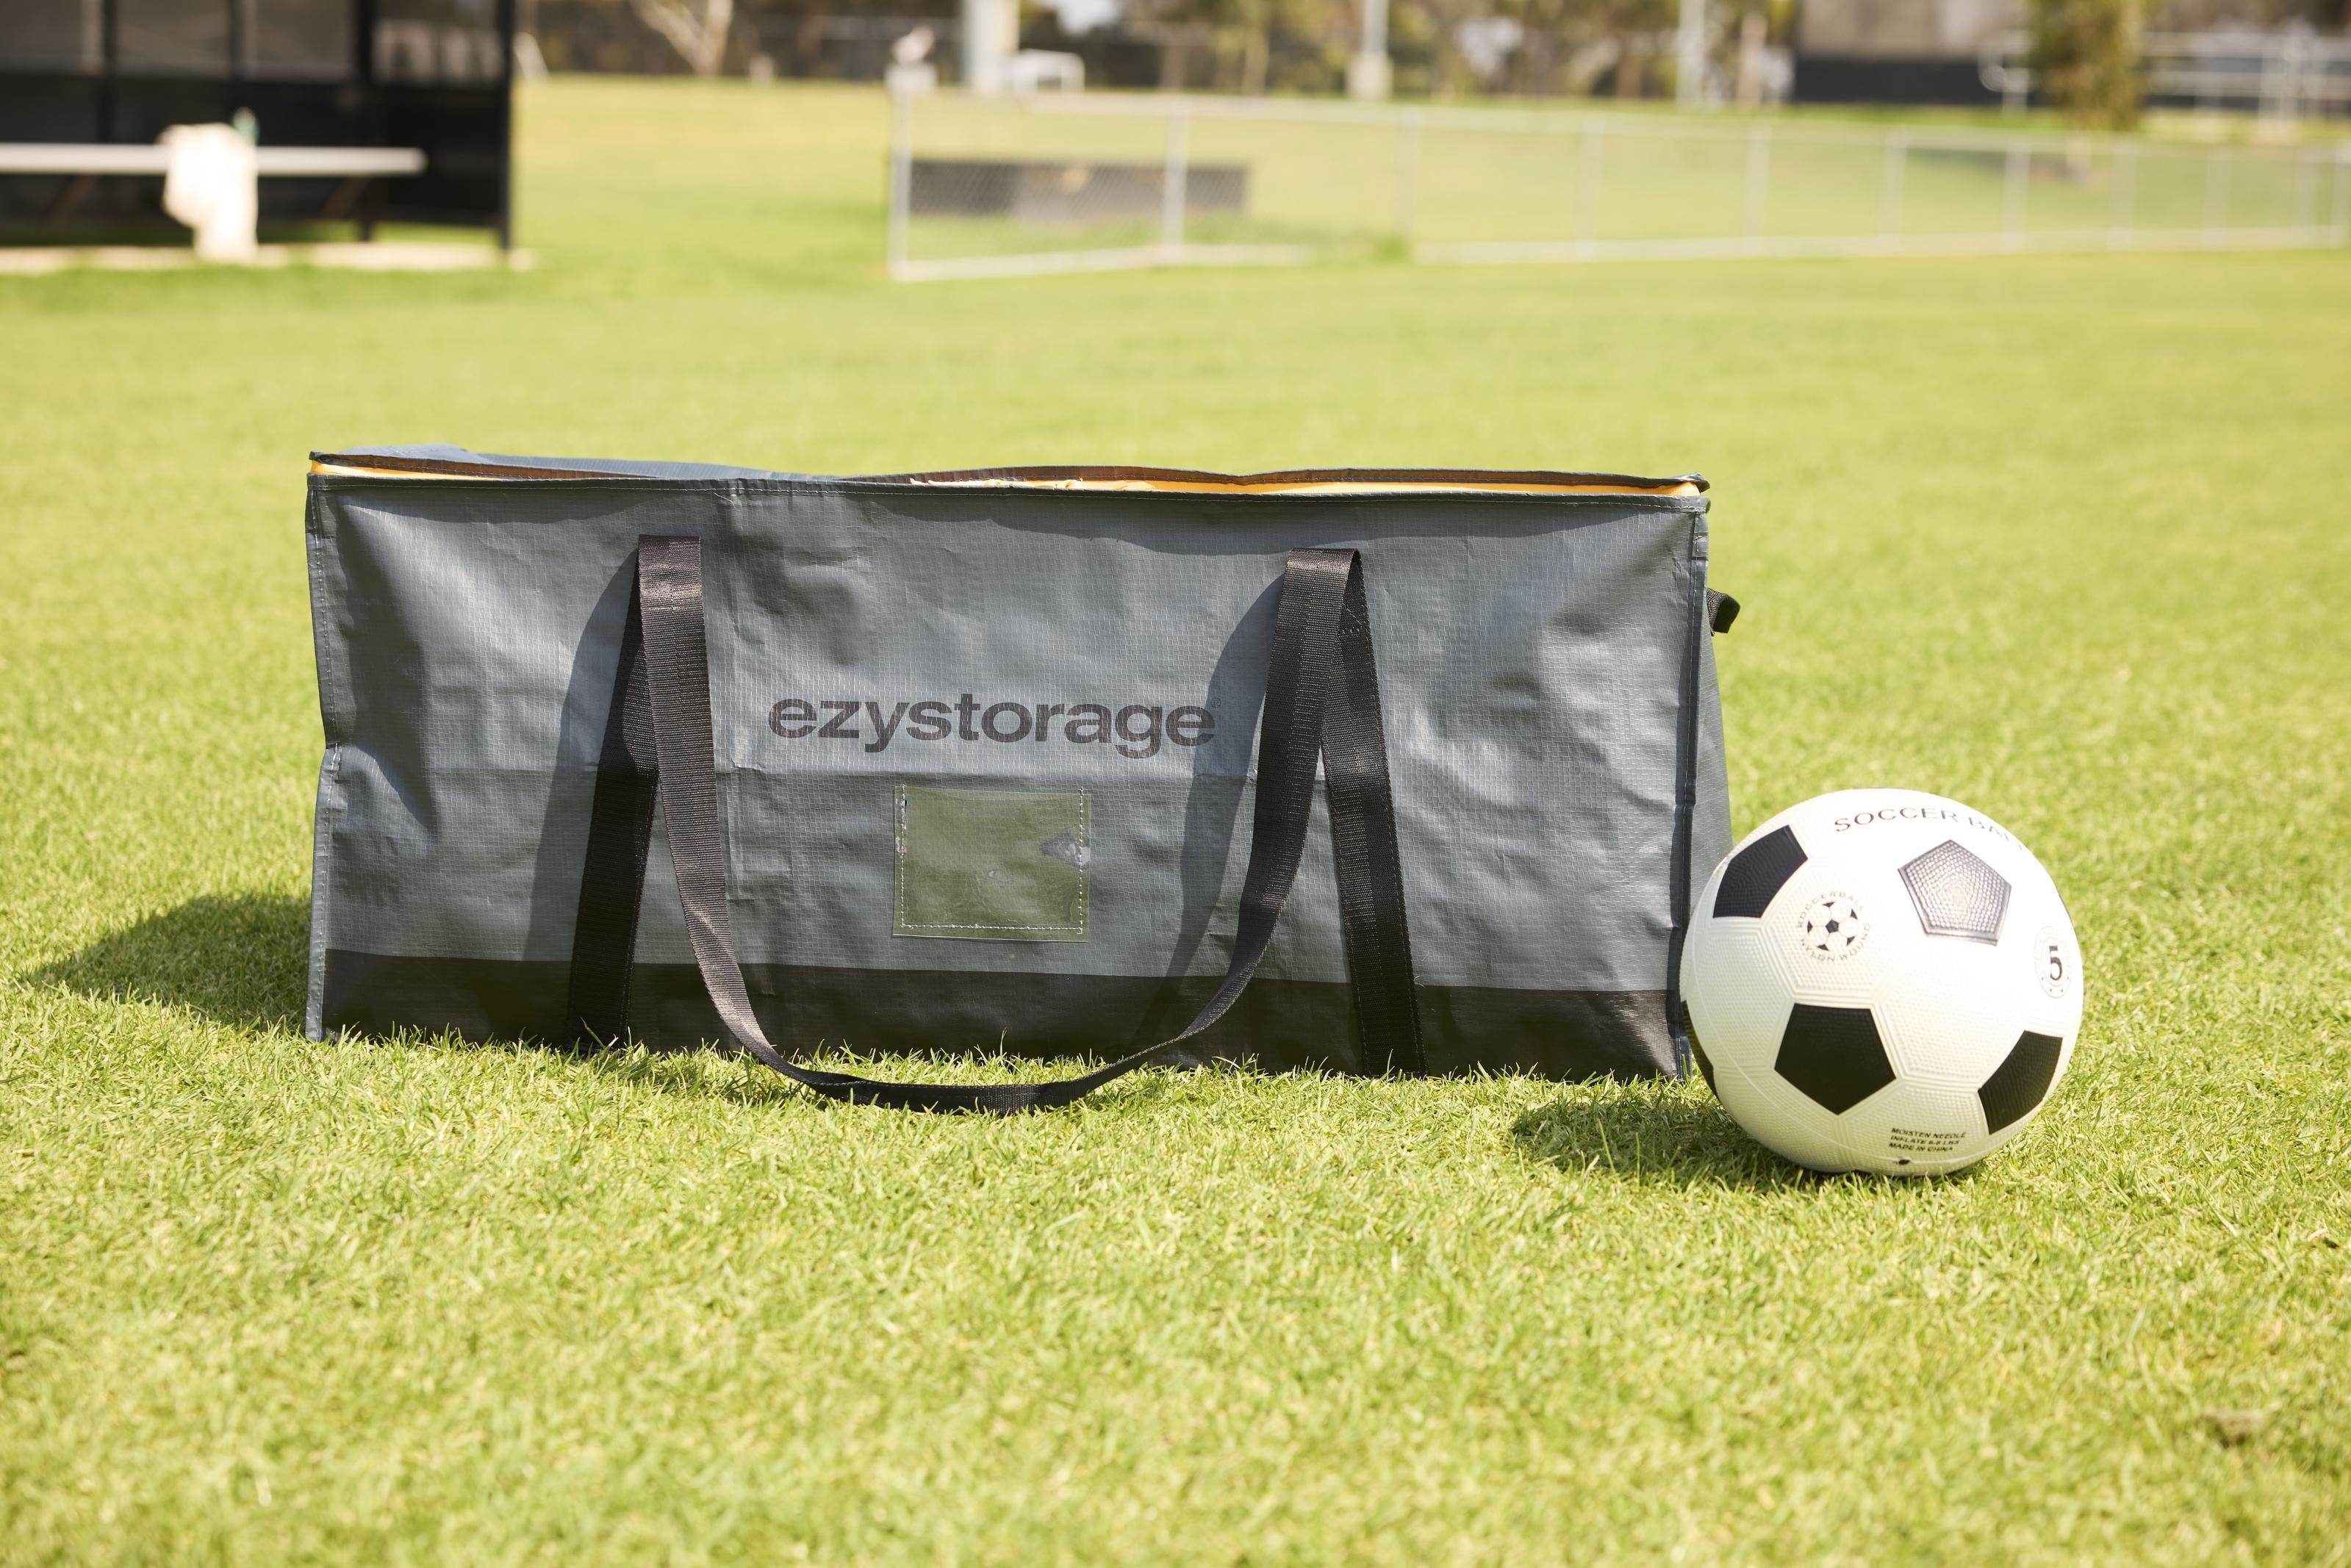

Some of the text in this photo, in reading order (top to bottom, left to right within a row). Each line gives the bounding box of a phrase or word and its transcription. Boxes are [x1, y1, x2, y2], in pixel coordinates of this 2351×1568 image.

[768, 693, 1216, 759] ezystorage
[1834, 808, 1959, 832] SOCCER
[2049, 945, 2062, 981] 5
[1888, 1142, 1914, 1151] MADE
